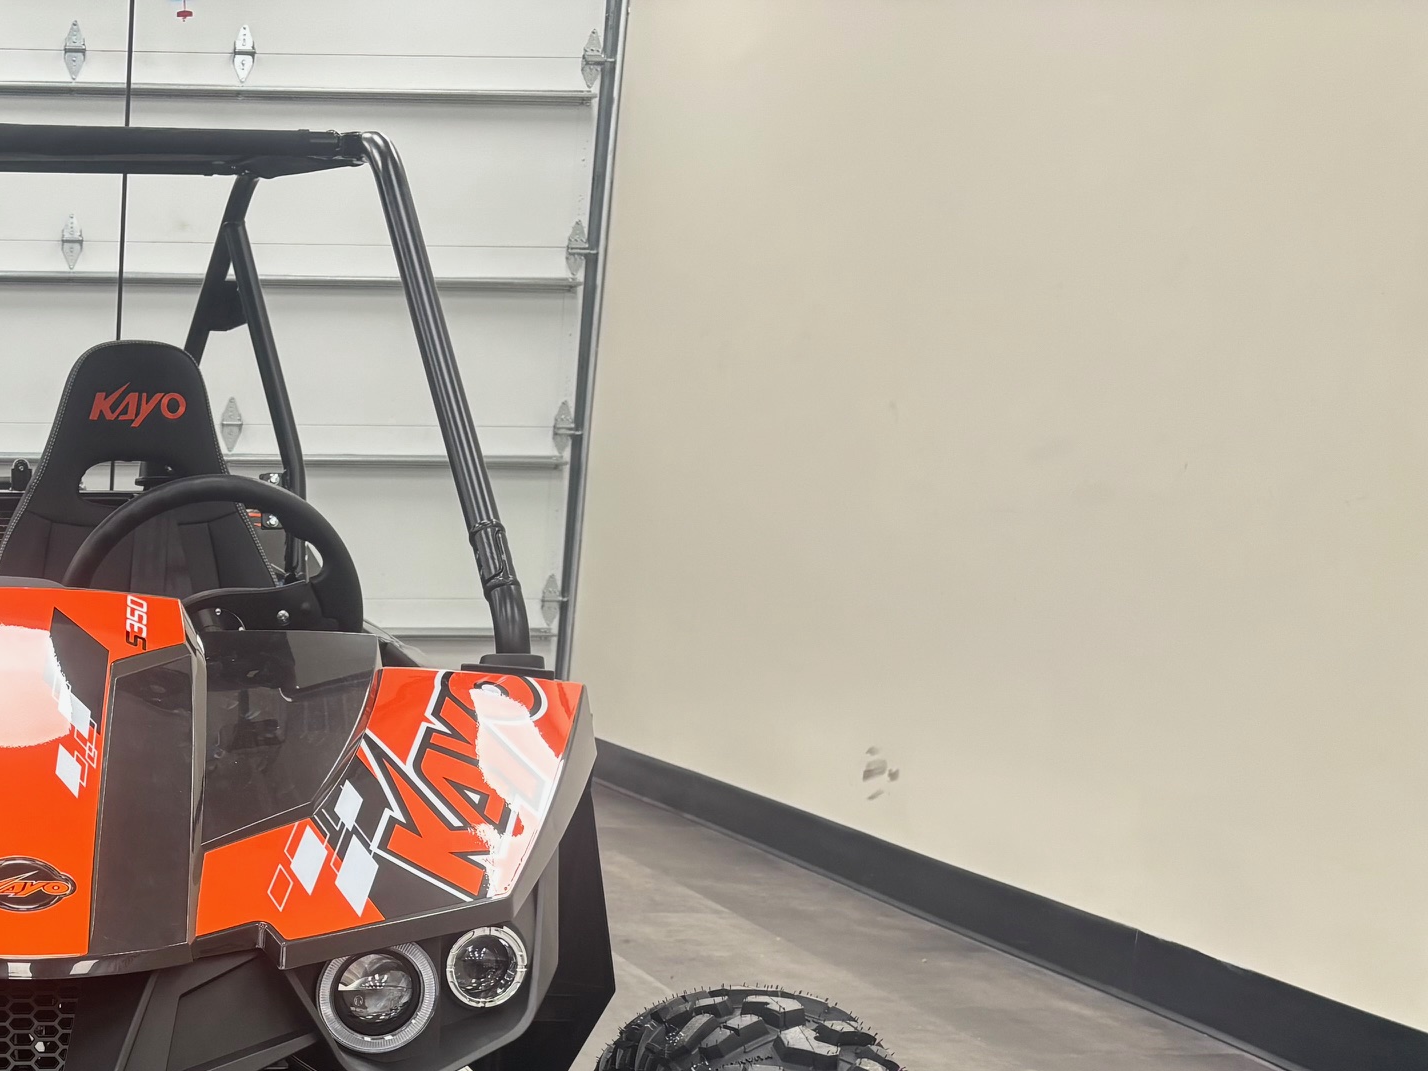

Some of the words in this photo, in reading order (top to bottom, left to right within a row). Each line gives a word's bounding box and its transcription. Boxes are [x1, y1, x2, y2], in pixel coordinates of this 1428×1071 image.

[89, 381, 187, 428] KAYO
[125, 594, 148, 652] S350
[362, 670, 562, 902] KAYO
